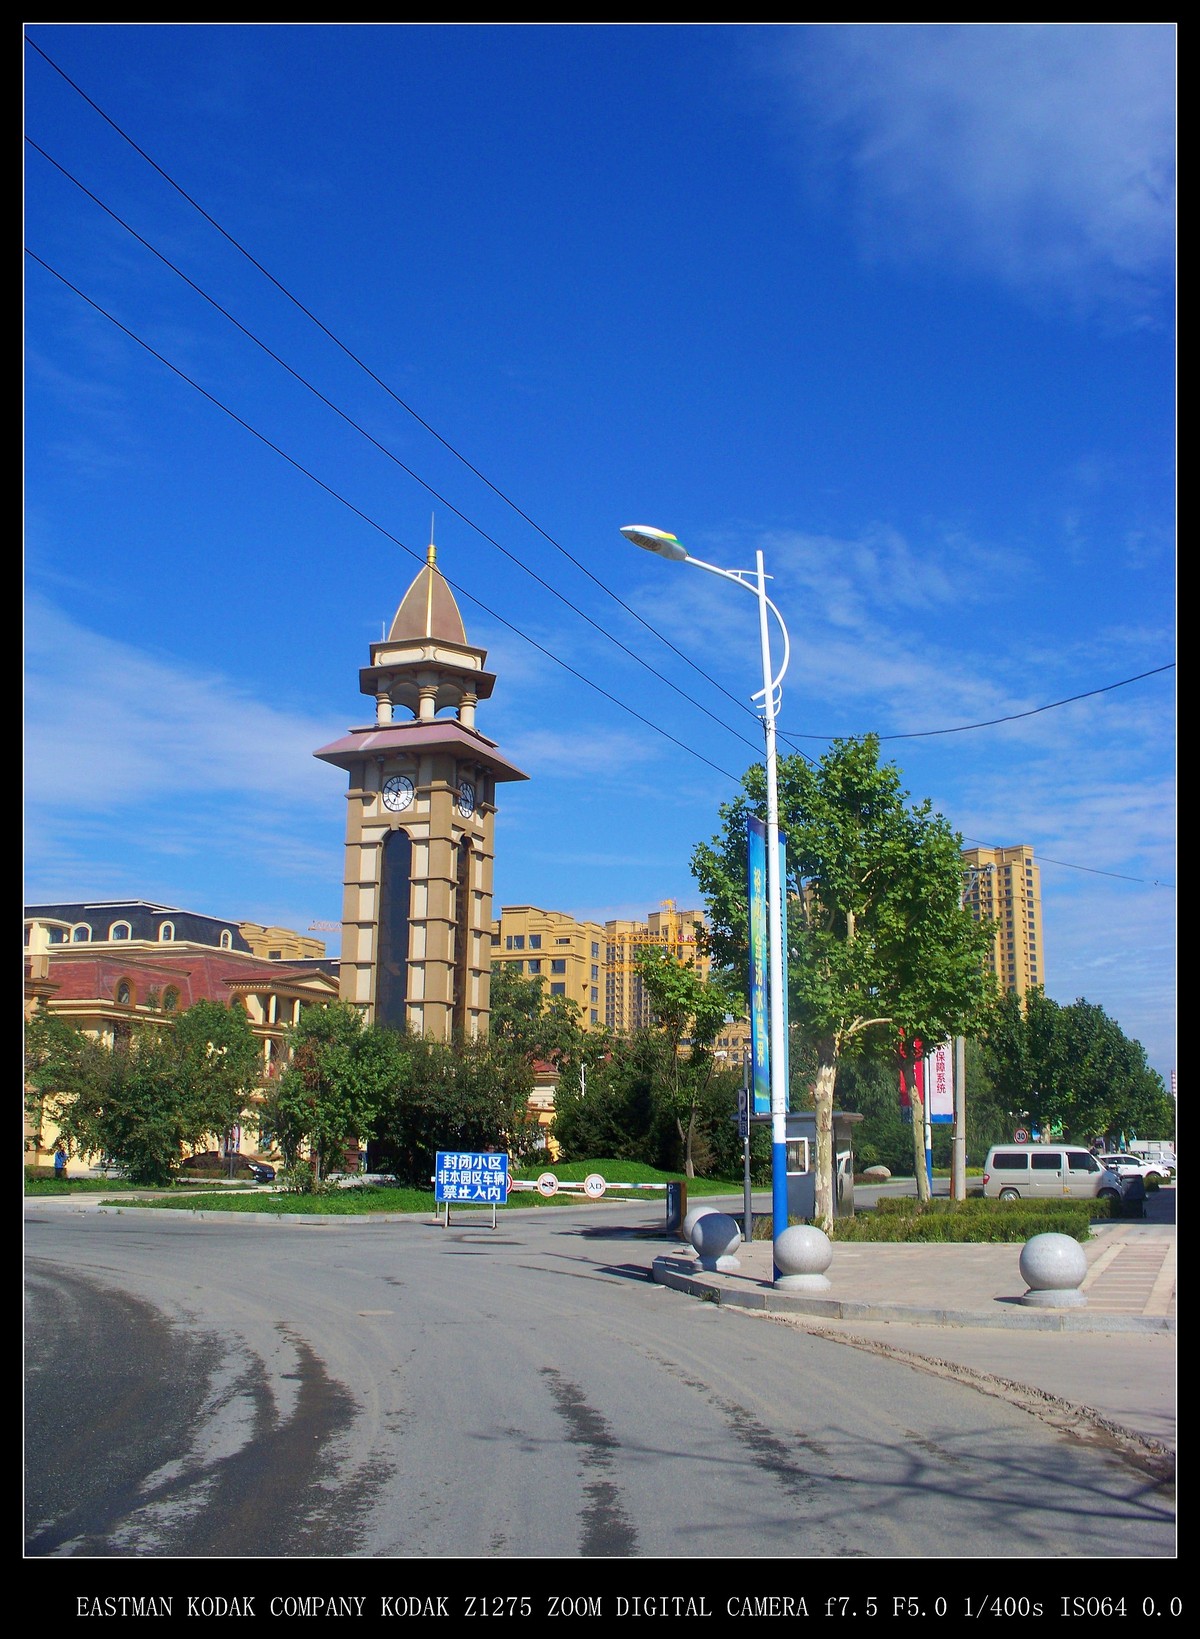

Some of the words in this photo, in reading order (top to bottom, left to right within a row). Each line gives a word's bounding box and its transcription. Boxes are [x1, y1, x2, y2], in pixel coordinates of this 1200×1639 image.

[935, 1046, 947, 1094] 保障系统
[443, 1154, 502, 1170] 封闭小区
[438, 1169, 505, 1186] 非本园区车辆
[588, 1182, 602, 1190] 入口
